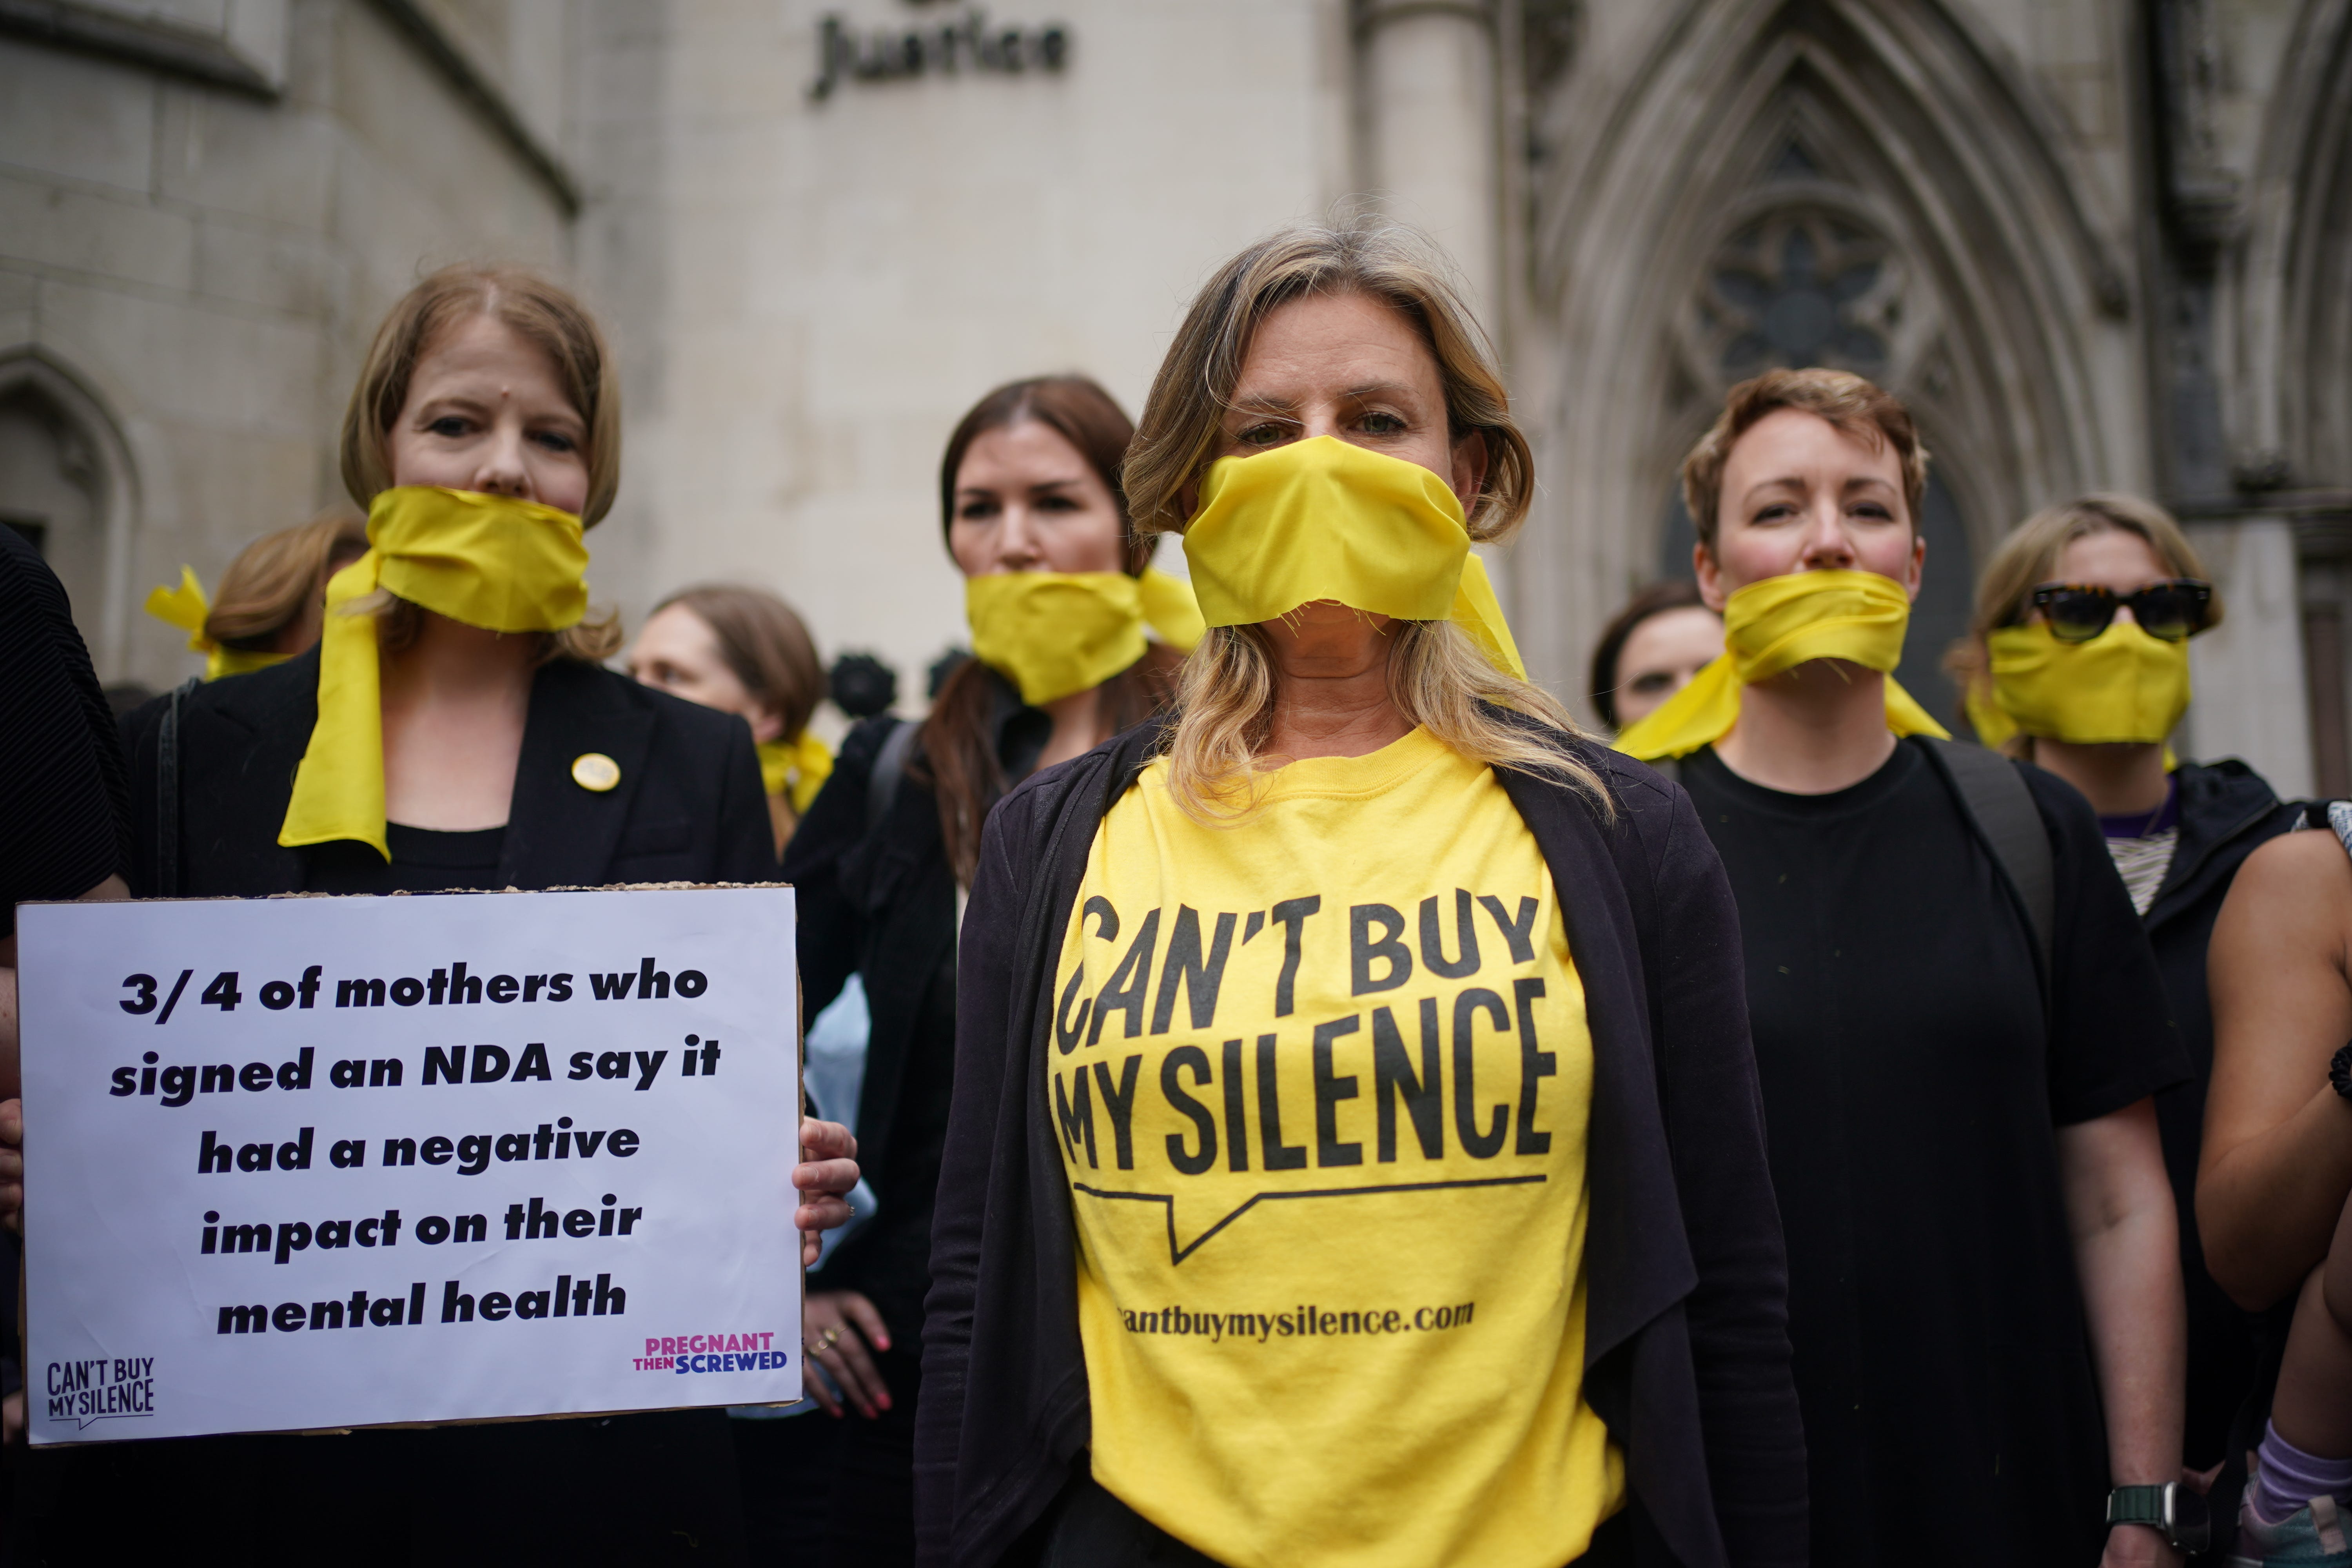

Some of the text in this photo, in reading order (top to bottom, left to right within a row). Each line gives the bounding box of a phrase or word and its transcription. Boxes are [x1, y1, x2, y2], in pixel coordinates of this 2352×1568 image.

[259, 965, 323, 1011] of
[335, 962, 574, 1008] mothers
[588, 957, 708, 1001] who
[1055, 887, 1539, 1055] CAN'T BUY
[109, 1034, 721, 1108] signed an NDA say it
[1054, 978, 1557, 1175] MY SILENCE
[197, 1116, 640, 1176] had a negative
[200, 1193, 643, 1265] impact on their
[216, 1273, 626, 1335] mental health
[645, 1332, 774, 1356] PREGNANT
[47, 1357, 154, 1396] CAN'T BUY
[48, 1378, 154, 1417] MY SILENCE
